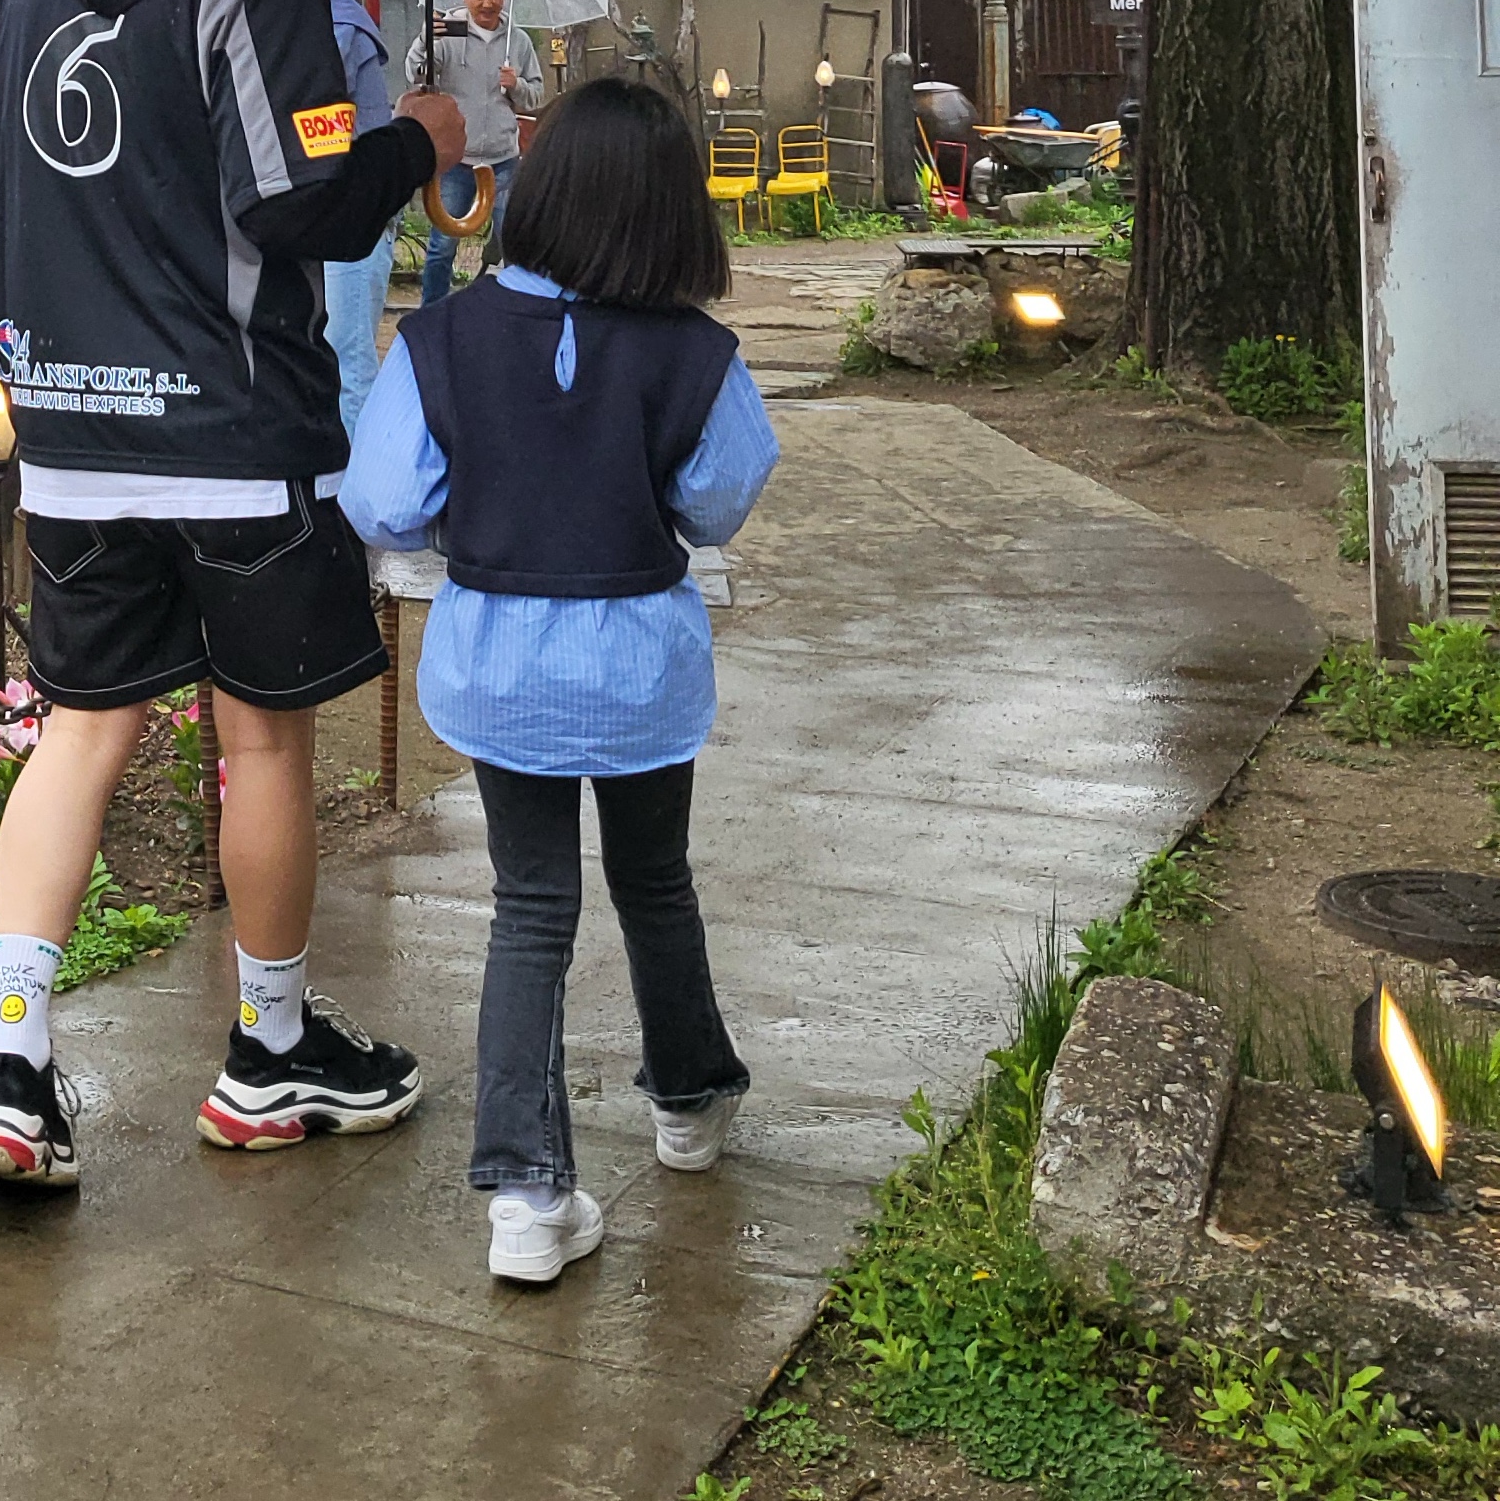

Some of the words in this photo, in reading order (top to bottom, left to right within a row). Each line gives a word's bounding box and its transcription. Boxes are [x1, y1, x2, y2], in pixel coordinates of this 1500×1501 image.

[23, 11, 125, 177] 6
[155, 372, 201, 395] S.L.
[82, 393, 166, 417] EXPRESS
